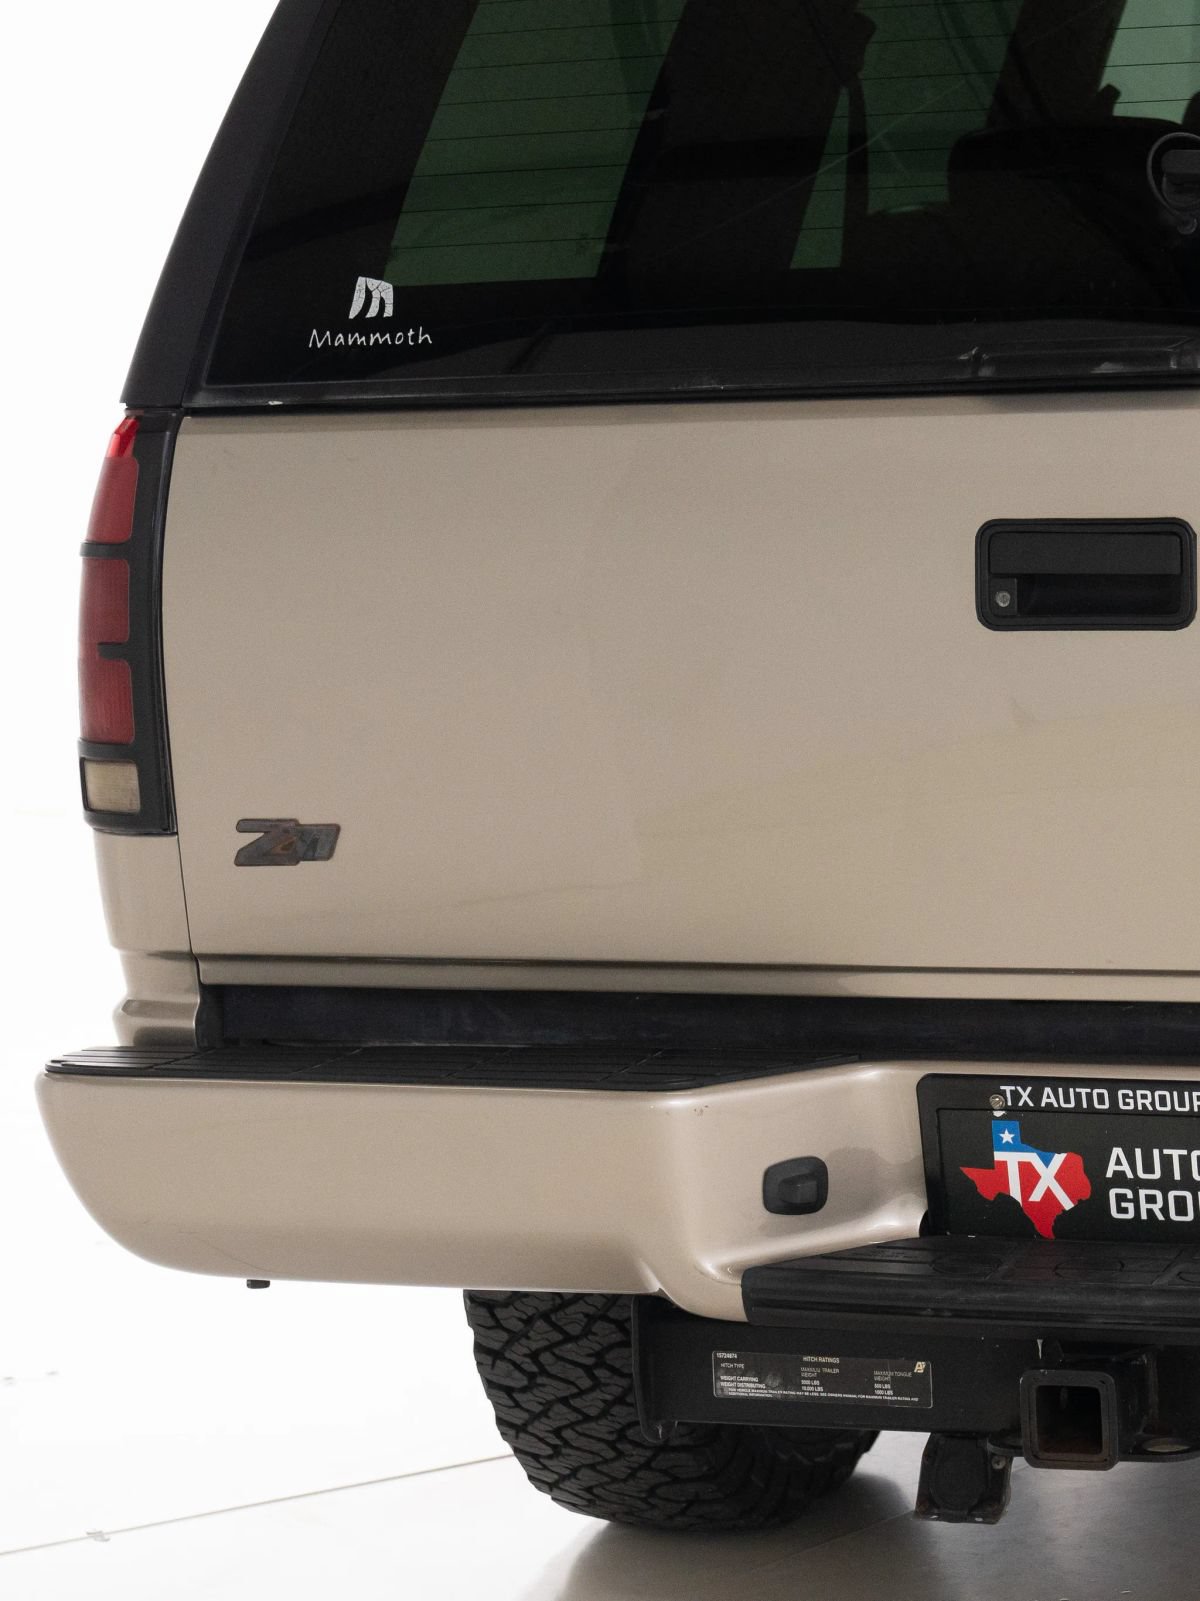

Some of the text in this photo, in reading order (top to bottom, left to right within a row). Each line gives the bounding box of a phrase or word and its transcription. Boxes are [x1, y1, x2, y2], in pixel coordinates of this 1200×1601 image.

[308, 326, 433, 349] Mammoth
[1000, 1085, 1034, 1107] TX
[1041, 1087, 1110, 1109] AUTO
[994, 1151, 1075, 1211] TX
